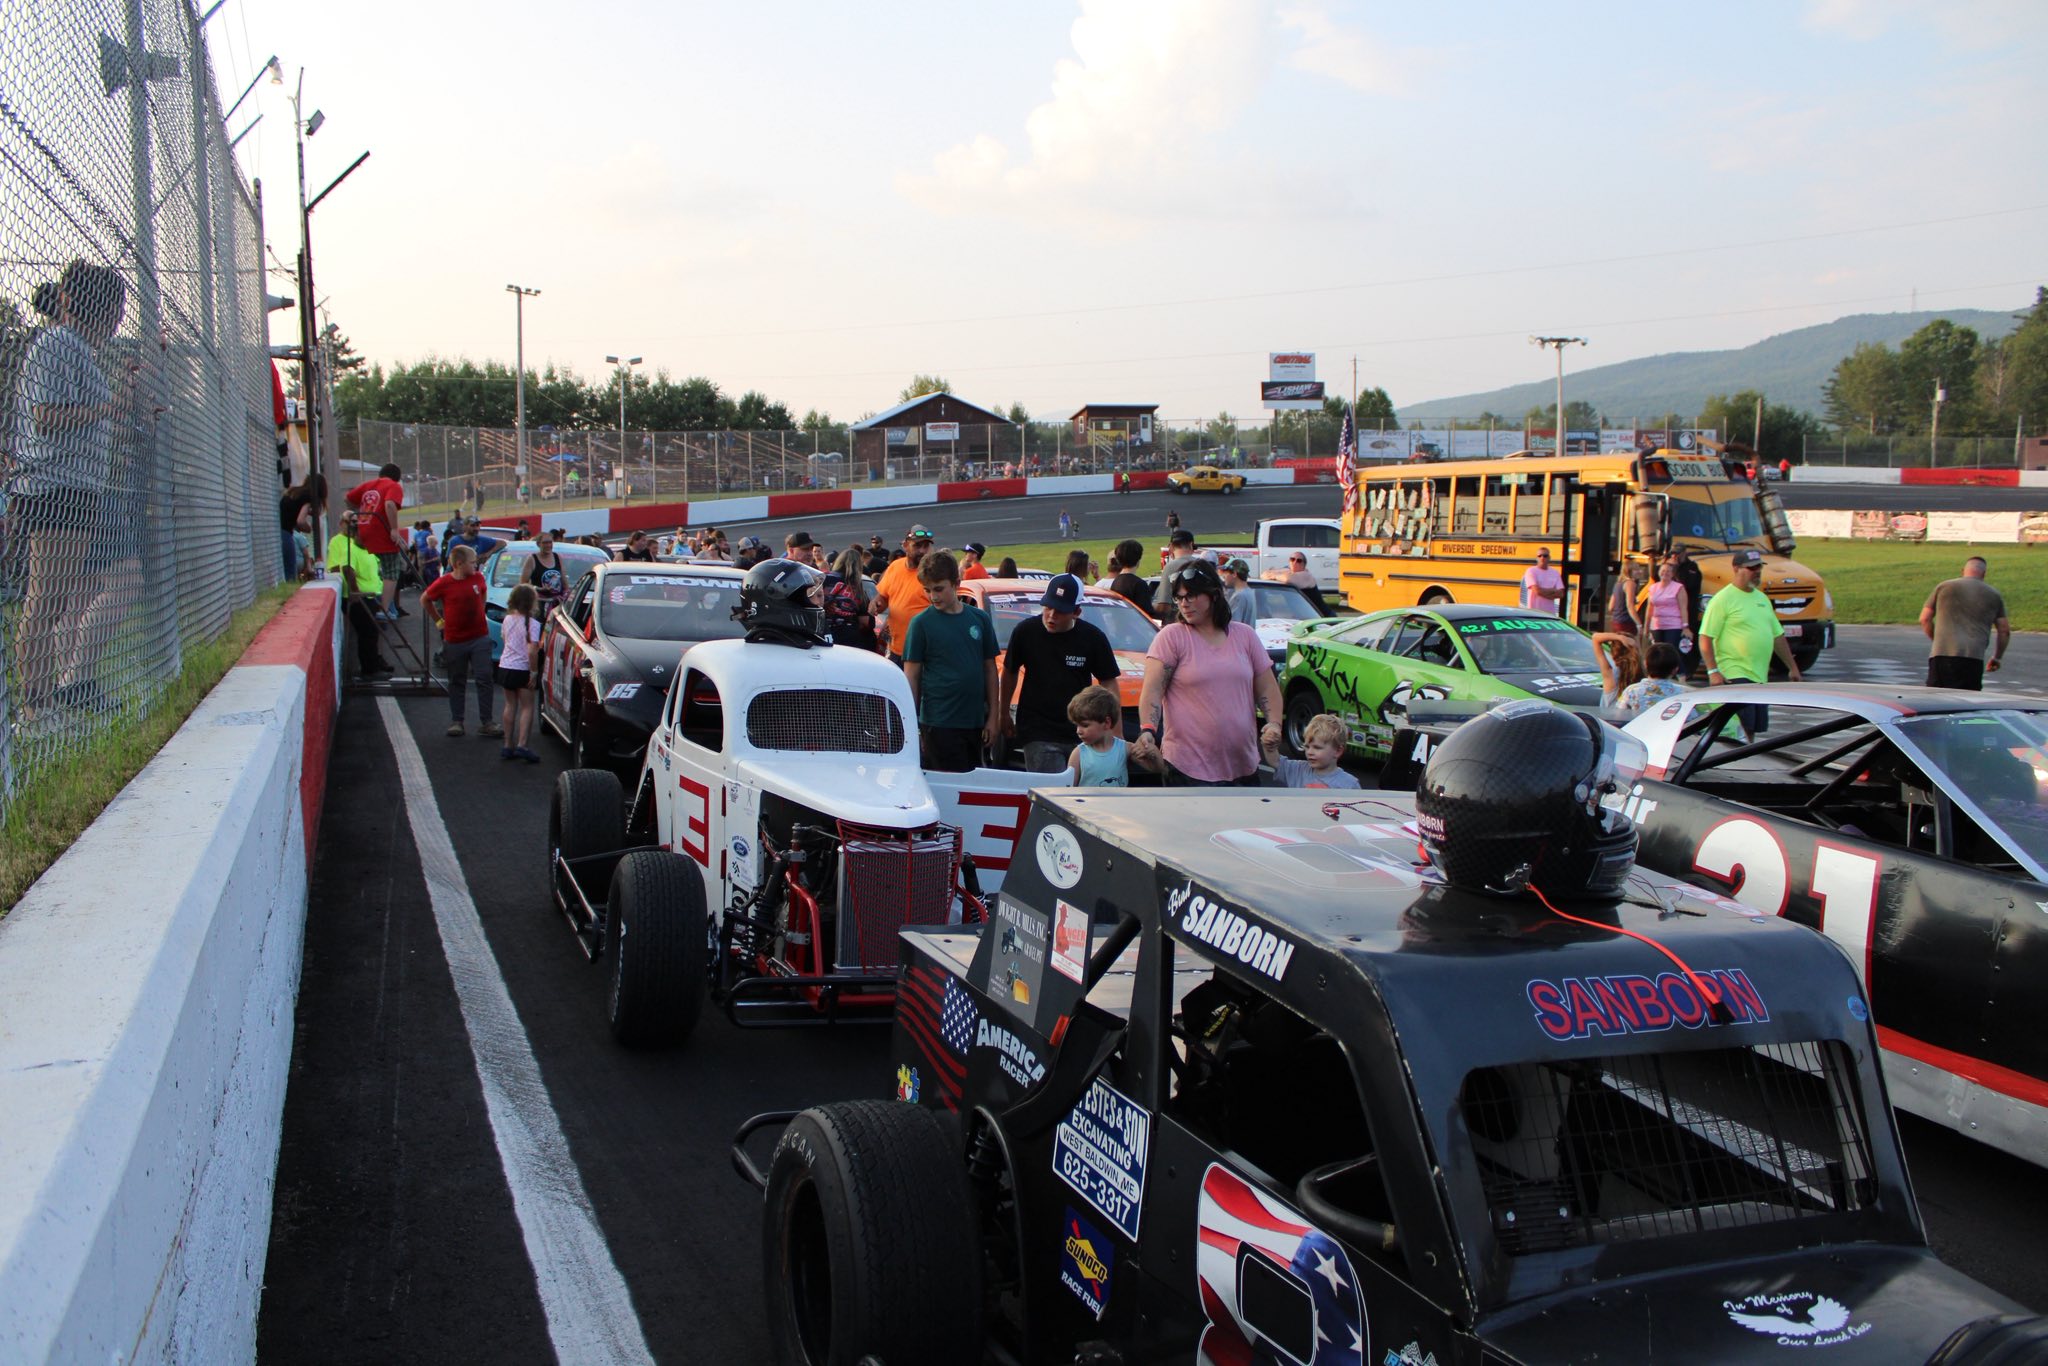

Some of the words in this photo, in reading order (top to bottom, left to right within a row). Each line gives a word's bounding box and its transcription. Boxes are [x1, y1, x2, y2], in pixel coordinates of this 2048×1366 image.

[1669, 463, 1706, 477] SCHOOL
[1707, 464, 1726, 478] BUS
[1442, 543, 1476, 554] RIVERSIDE
[1481, 545, 1518, 555] SPEEDWAY
[988, 593, 1128, 608] SHEON
[607, 683, 644, 699] 85
[1168, 879, 1192, 917] Brad
[1692, 813, 1884, 1008] 21
[1182, 896, 1295, 981] SANBORN
[1000, 1055, 1029, 1088] RACER
[1072, 1109, 1132, 1170] EXCAVATING
[1063, 1127, 1084, 1151] WEST
[1121, 1177, 1136, 1198] ME.
[1063, 1152, 1131, 1224] 625-3317
[1068, 1239, 1106, 1281] SUNOCO
[1061, 1270, 1083, 1297] RACE
[1723, 1301, 1746, 1311] In
[1745, 1291, 1813, 1307] Memory
[1776, 1304, 1793, 1315] of
[1777, 1336, 1808, 1346] Our
[1814, 1331, 1851, 1346] Loved
